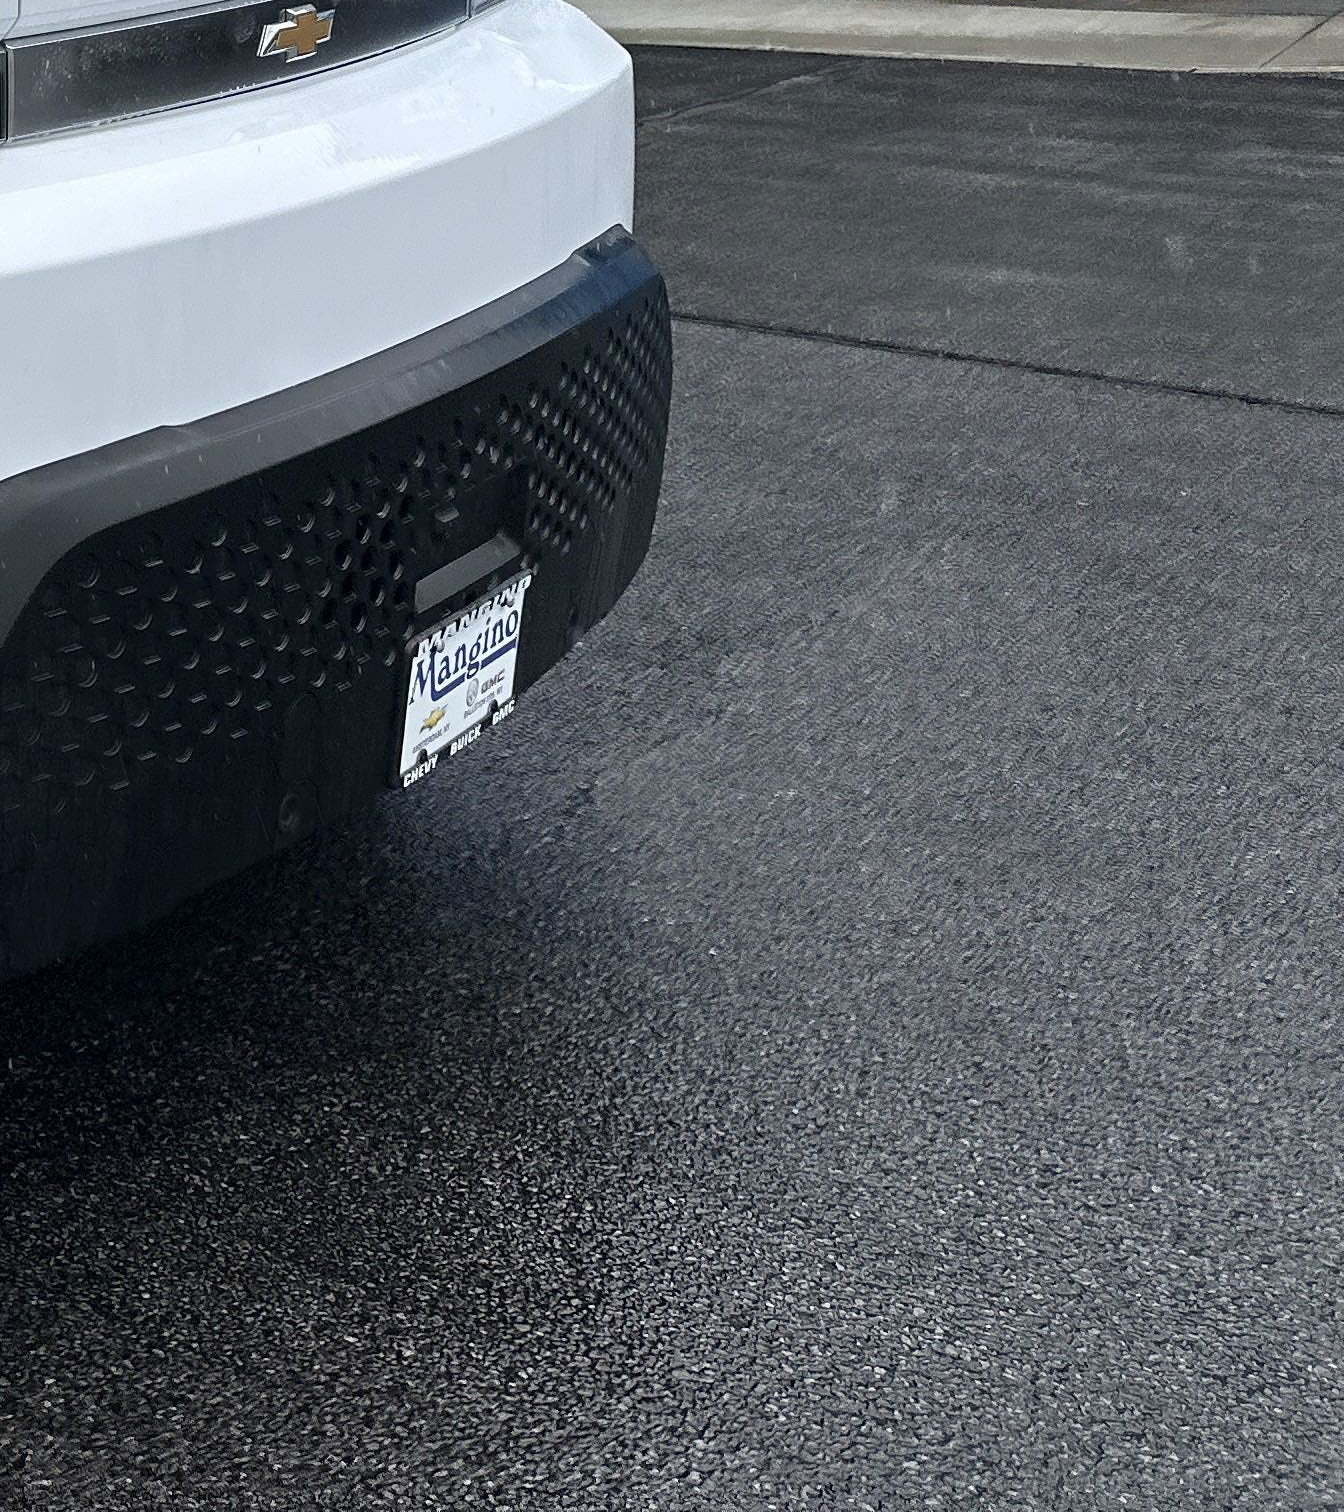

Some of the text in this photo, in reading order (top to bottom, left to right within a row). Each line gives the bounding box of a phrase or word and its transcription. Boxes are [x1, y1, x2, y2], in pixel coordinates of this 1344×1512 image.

[408, 609, 519, 705] Mangino
[403, 699, 516, 788] CHEVY BUICK GMC
